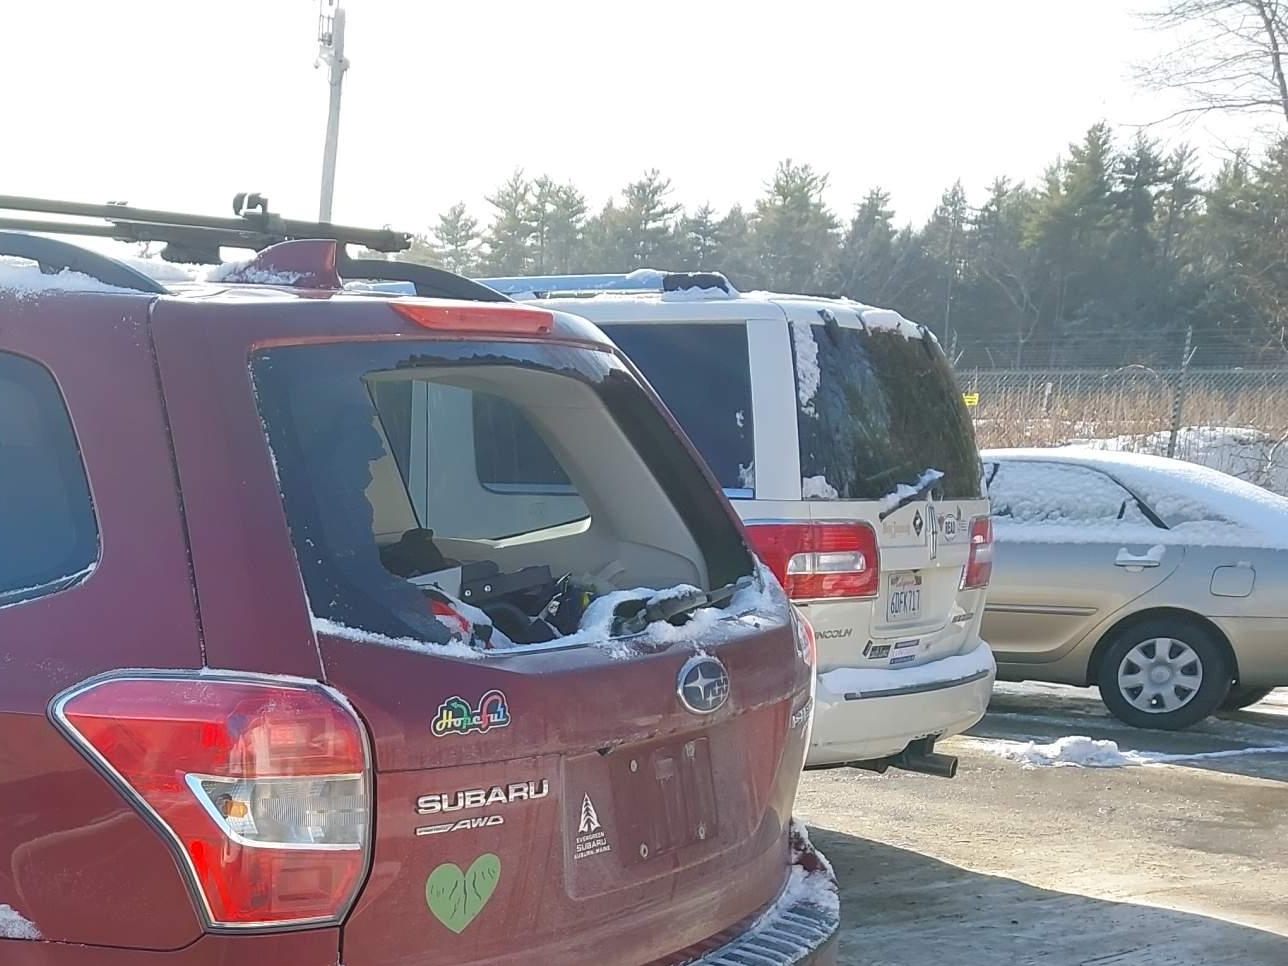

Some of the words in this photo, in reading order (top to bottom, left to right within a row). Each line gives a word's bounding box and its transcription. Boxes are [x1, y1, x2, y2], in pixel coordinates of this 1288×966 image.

[435, 694, 508, 732] Hopeful
[417, 779, 549, 815] SUBARU
[451, 815, 504, 832] AWD
[576, 831, 605, 844] EVERGREEN
[576, 837, 607, 853] SUBARU
